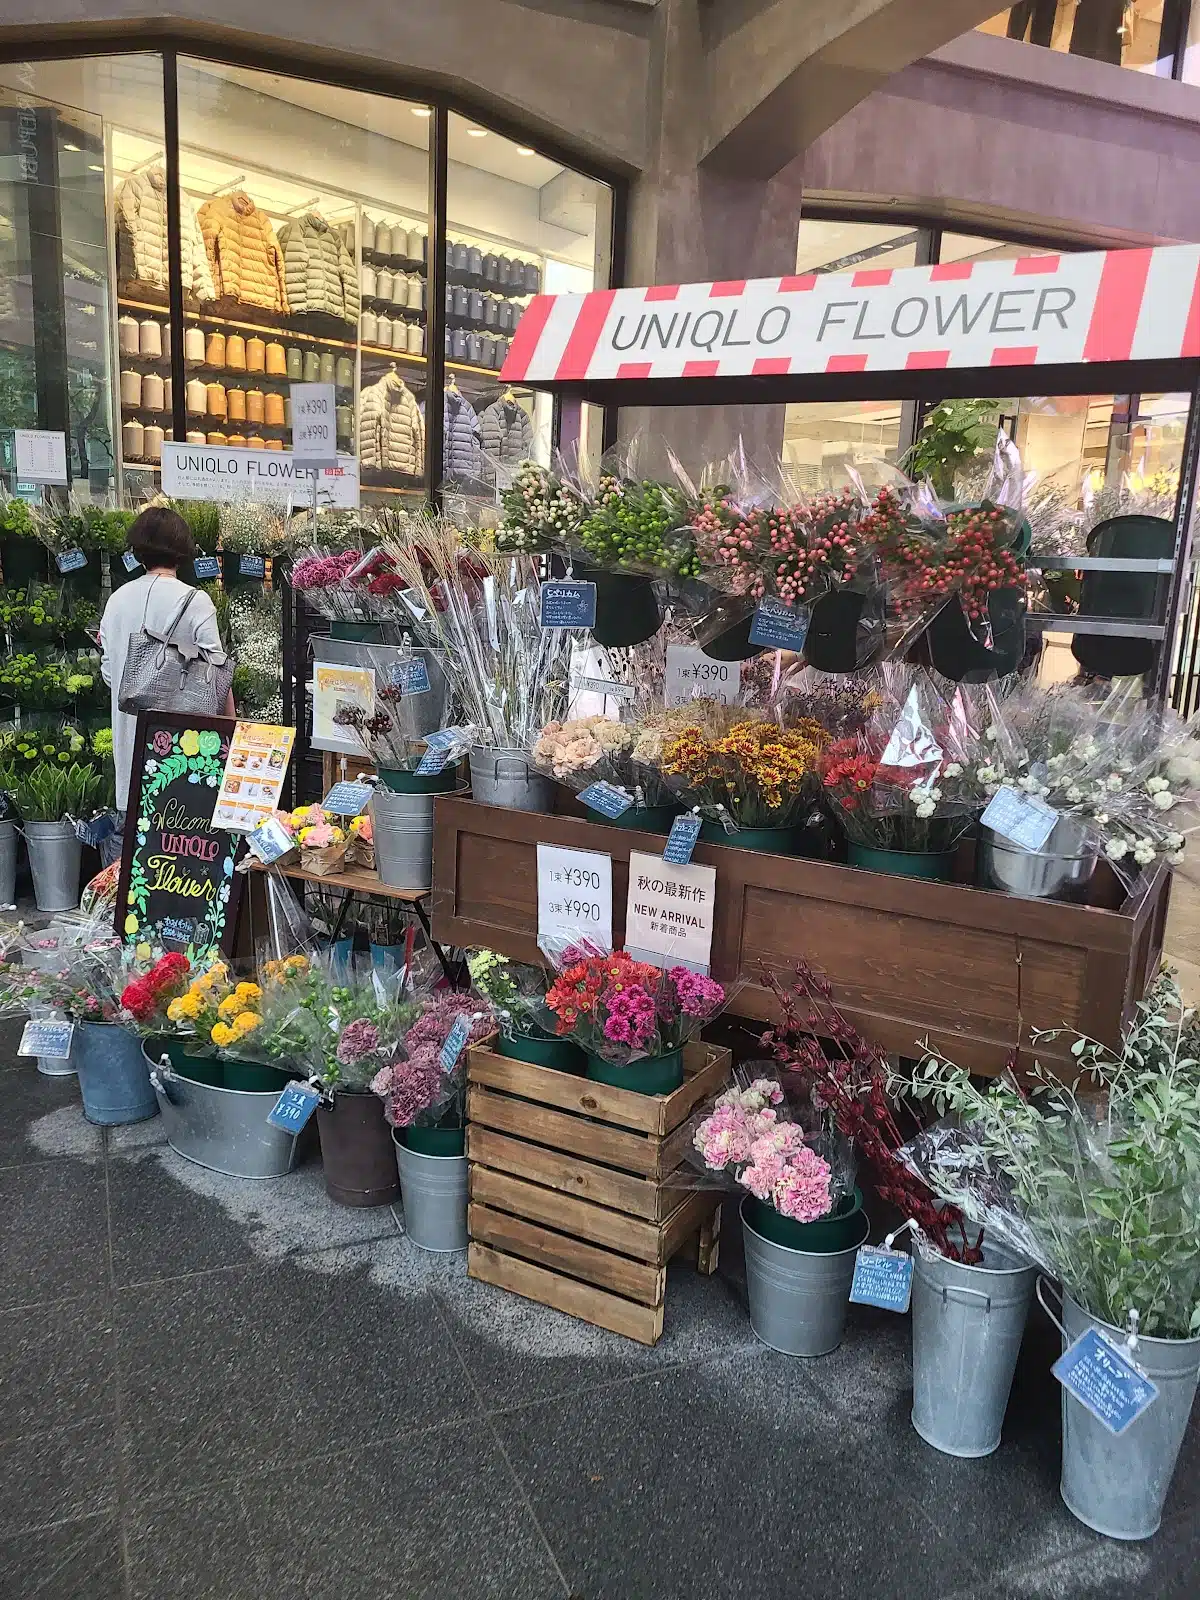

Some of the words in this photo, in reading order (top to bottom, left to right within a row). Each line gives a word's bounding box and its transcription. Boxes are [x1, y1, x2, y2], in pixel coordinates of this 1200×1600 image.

[610, 305, 791, 353] UNIQLO
[815, 287, 1077, 342] FLOWER
[176, 455, 238, 475] UNIQLO
[161, 832, 220, 862] UNIQLO
[145, 854, 217, 902] Flower
[637, 875, 707, 904] 秋の最新作
[634, 903, 658, 918] NEW
[660, 909, 706, 930] ARRIVAL
[650, 921, 687, 938] 新着商品
[1094, 1347, 1131, 1380] オリーブ
